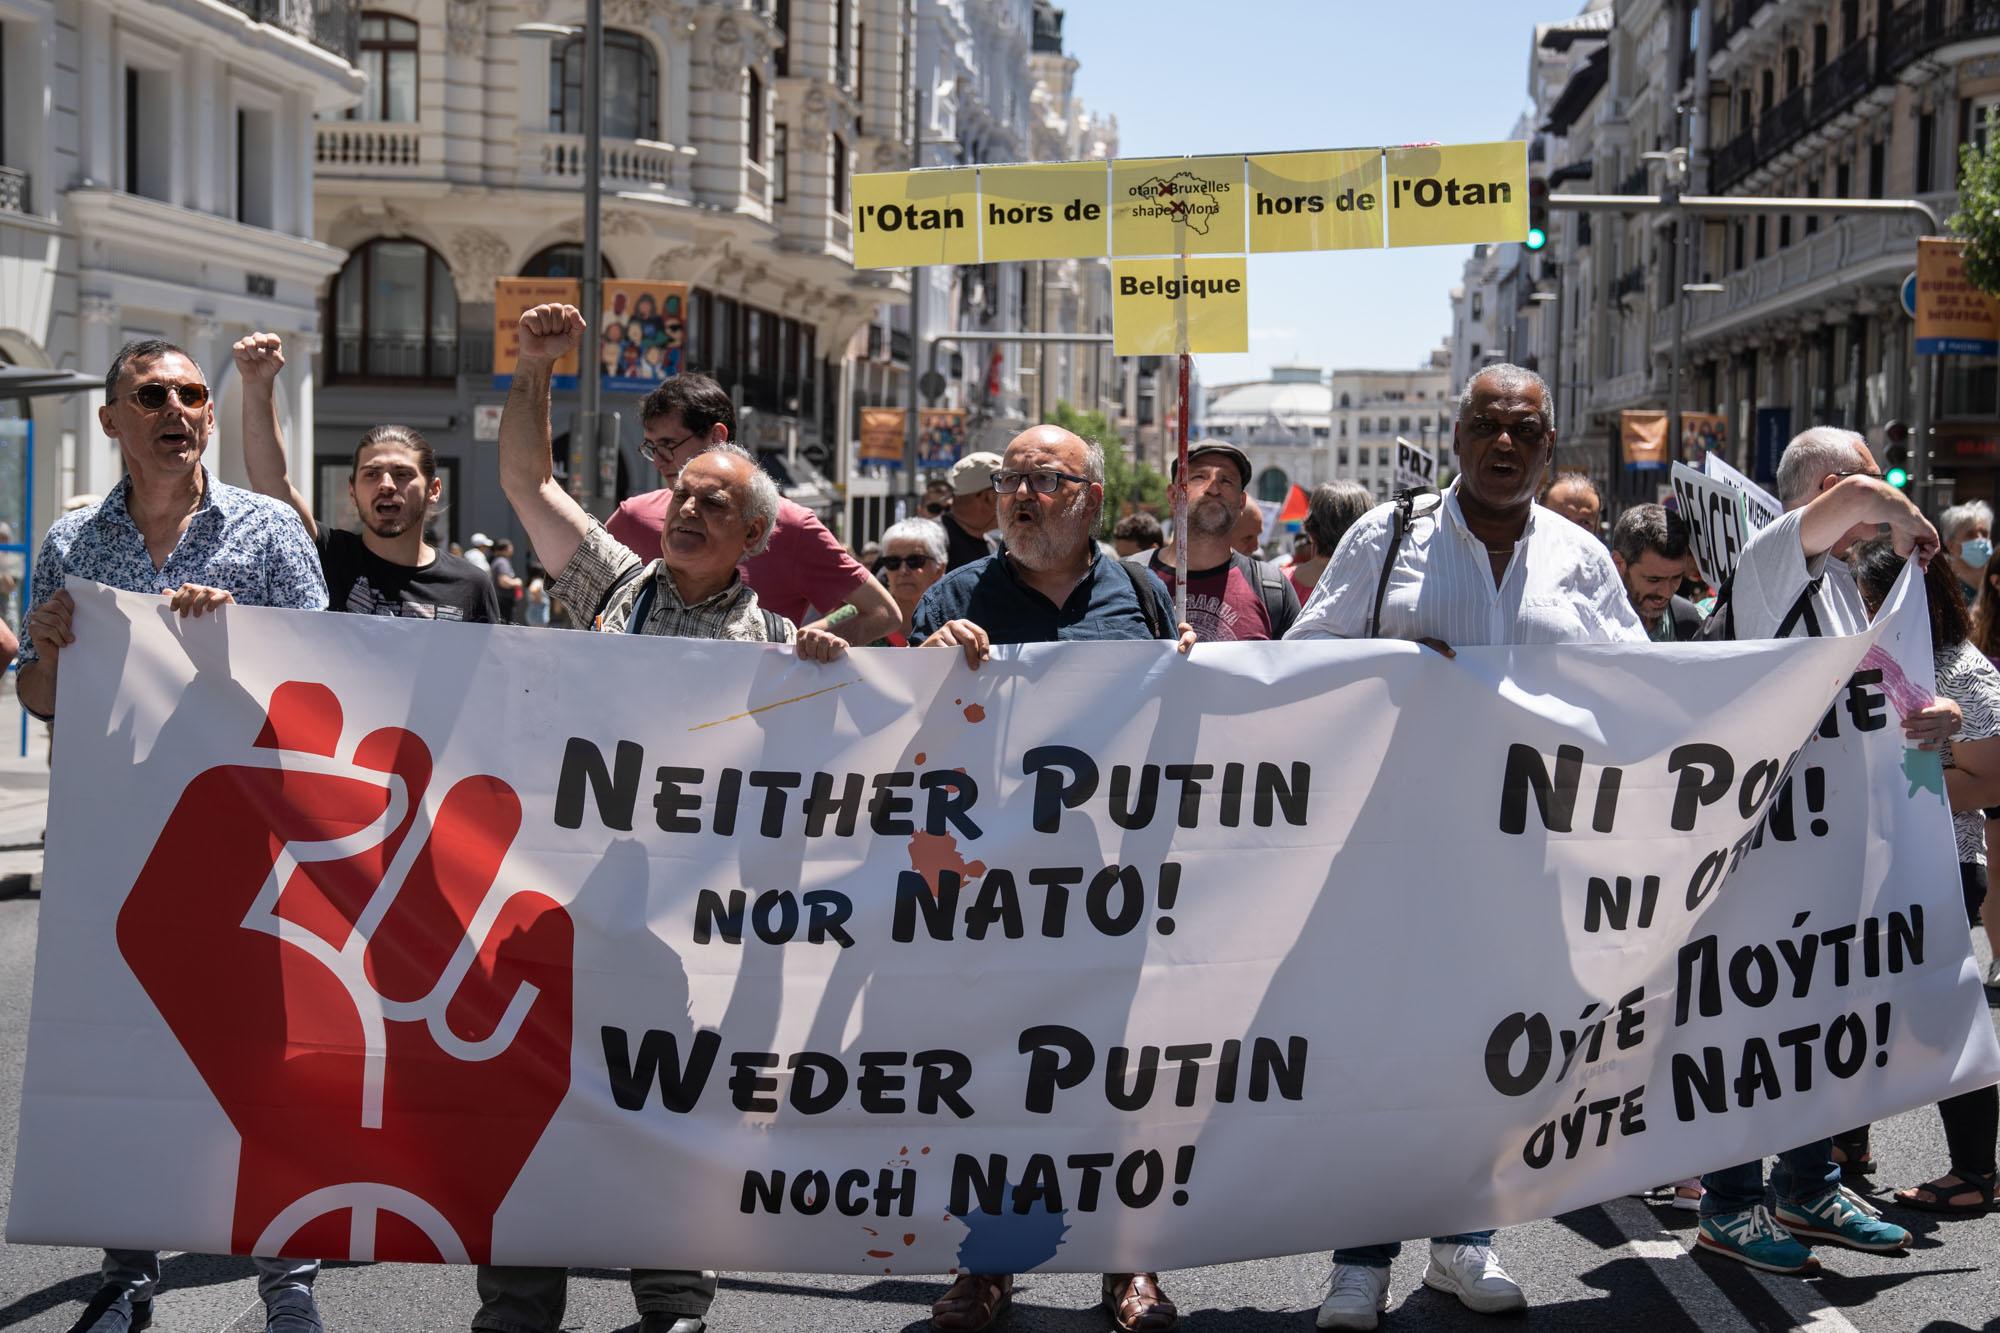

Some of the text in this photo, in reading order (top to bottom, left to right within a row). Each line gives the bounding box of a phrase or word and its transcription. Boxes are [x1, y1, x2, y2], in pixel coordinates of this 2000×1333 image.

[1129, 180, 1231, 197] otan Bruxelles
[1132, 203, 1220, 219] shape Mons
[1257, 178, 1512, 215] hors de l'Otan
[858, 199, 1101, 233] l'Otan hors de
[1120, 275, 1241, 303] Belgique
[1399, 443, 1433, 481] PAZ
[554, 737, 1311, 841] NEITHER PUTIN
[1499, 743, 1623, 835] NI
[693, 862, 1182, 949] NOR NATO!
[1583, 875, 1661, 933] NI
[600, 1024, 1308, 1119] WEDER PUTIN
[739, 1145, 1196, 1218] NOCH NATO!
